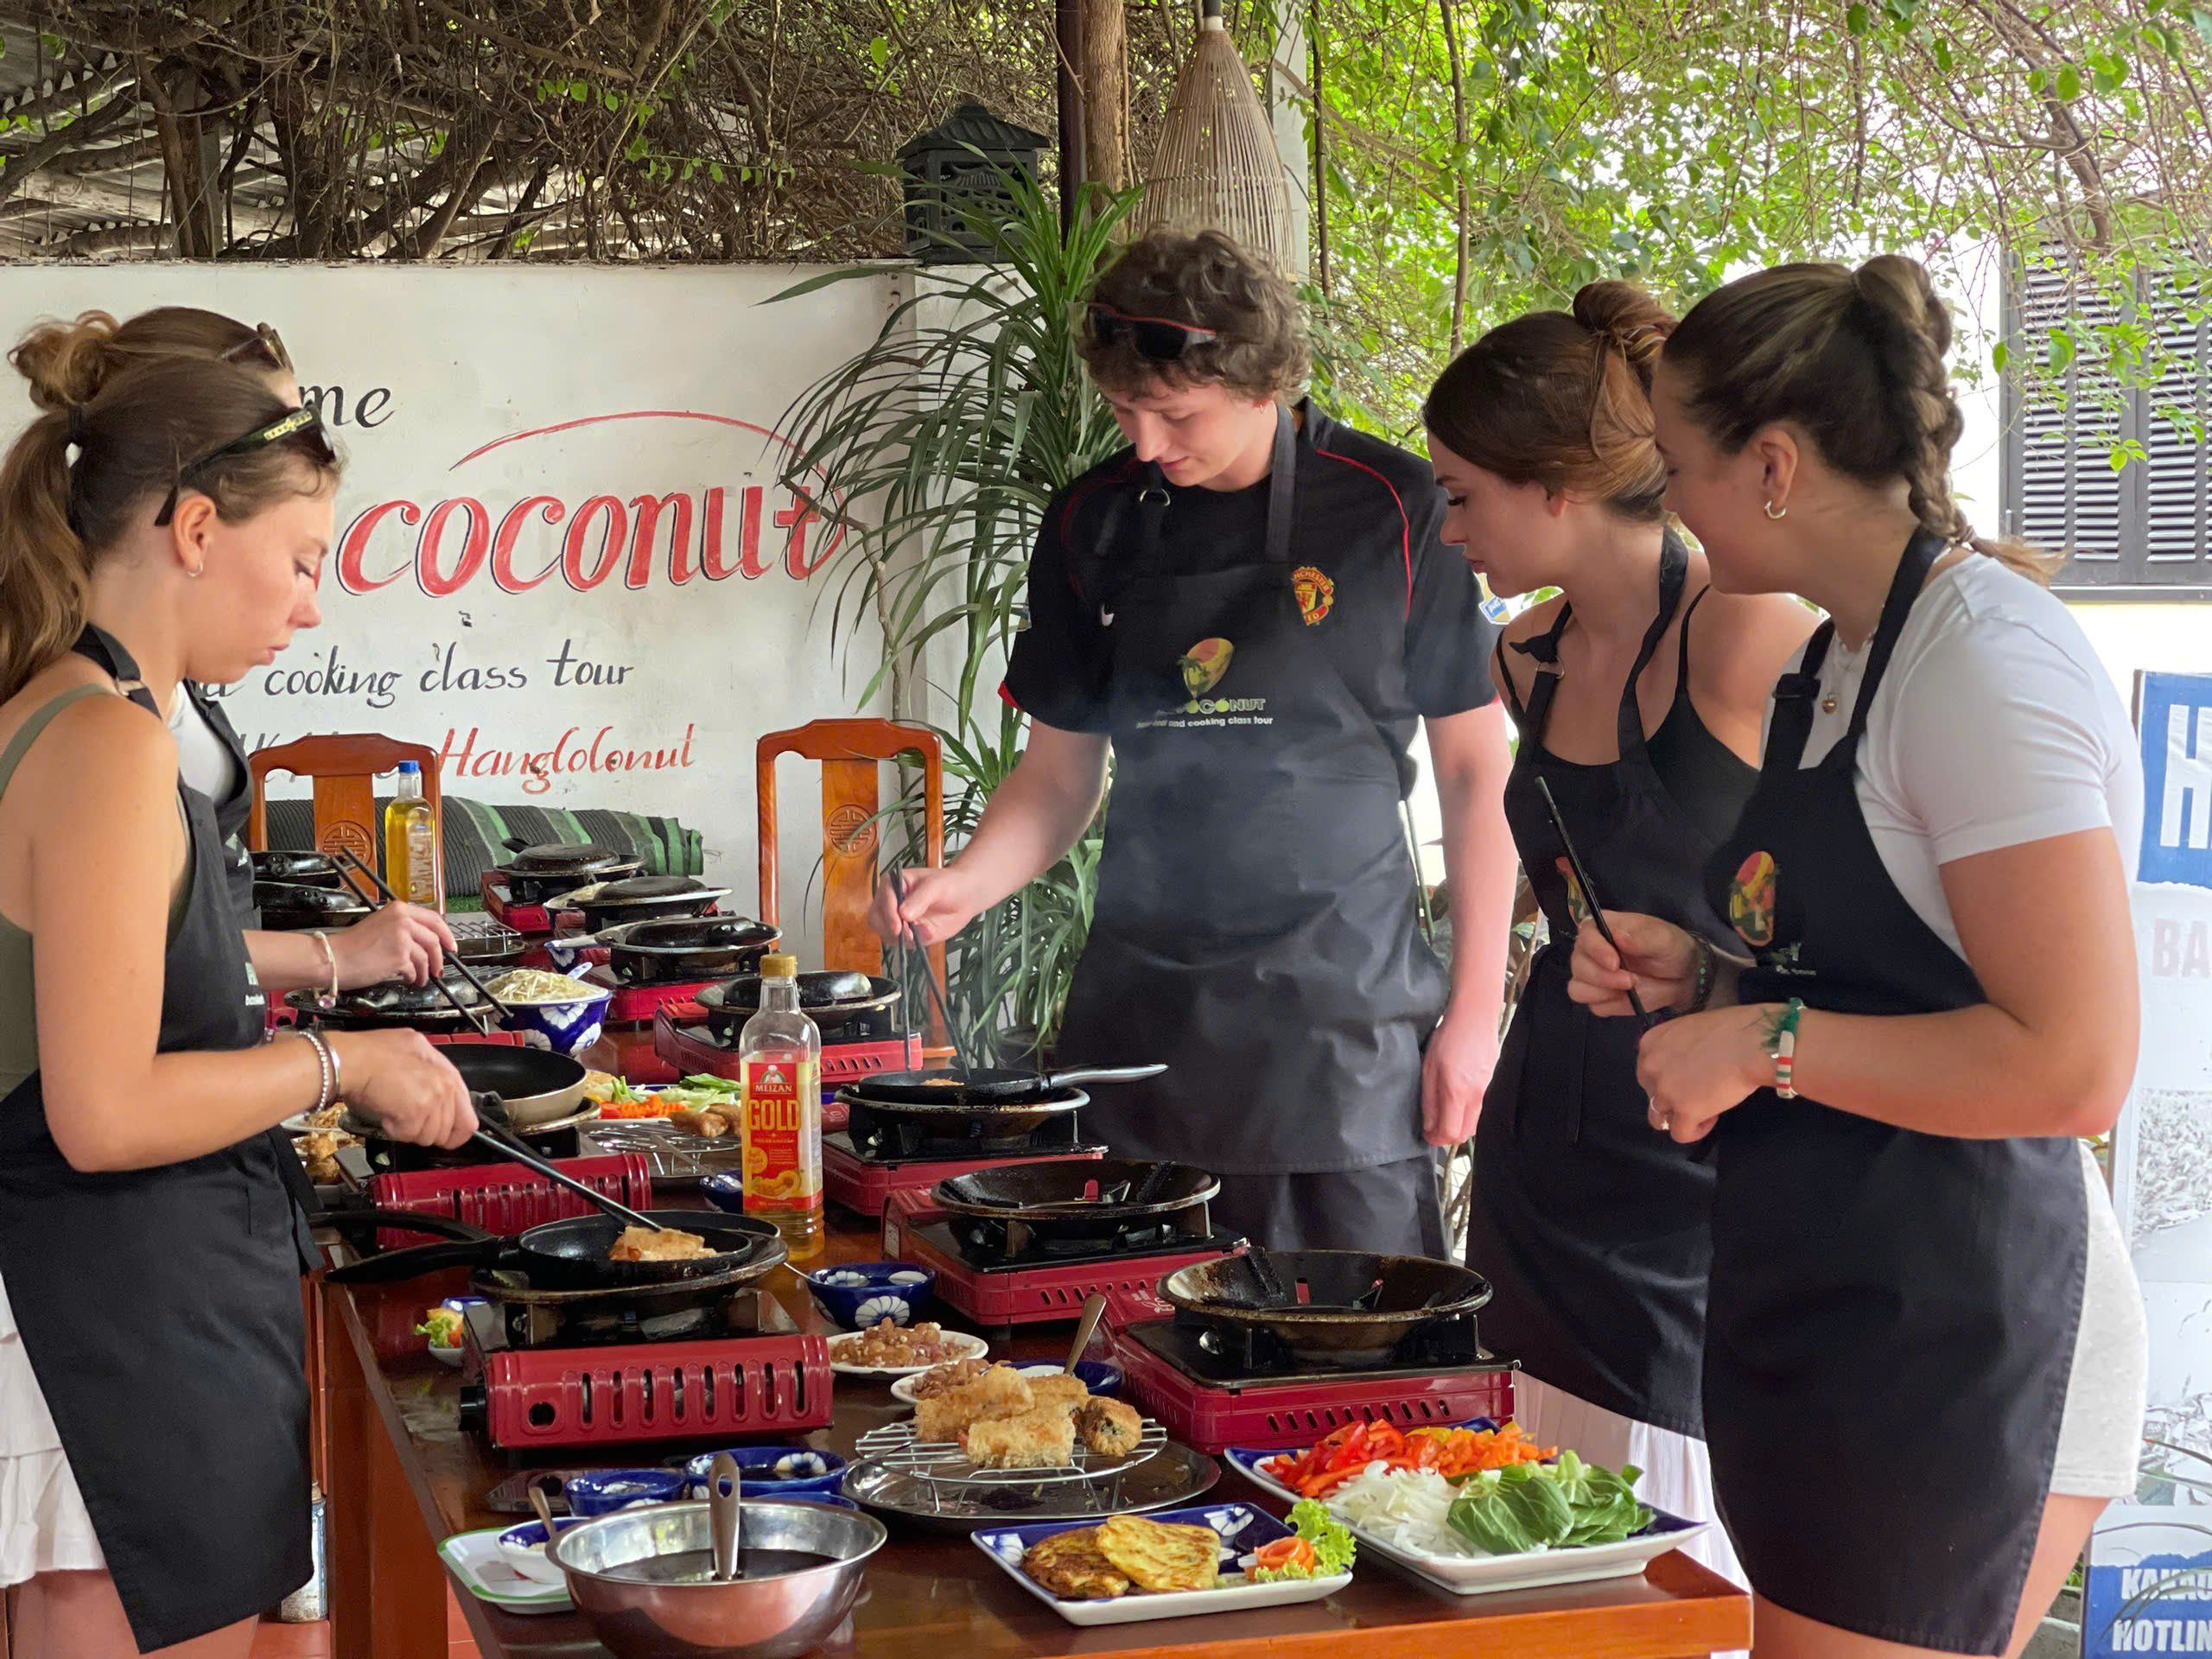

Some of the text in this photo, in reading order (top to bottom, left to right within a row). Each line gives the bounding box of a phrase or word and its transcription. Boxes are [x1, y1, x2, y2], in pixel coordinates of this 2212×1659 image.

[335, 486, 826, 598] coconut
[264, 639, 634, 709] cooking class tour
[1187, 718, 1225, 728] cooking
[1228, 716, 1252, 725] class
[1254, 715, 1274, 724] tour
[2160, 703, 2212, 850] H
[747, 1099, 801, 1131] GOLD
